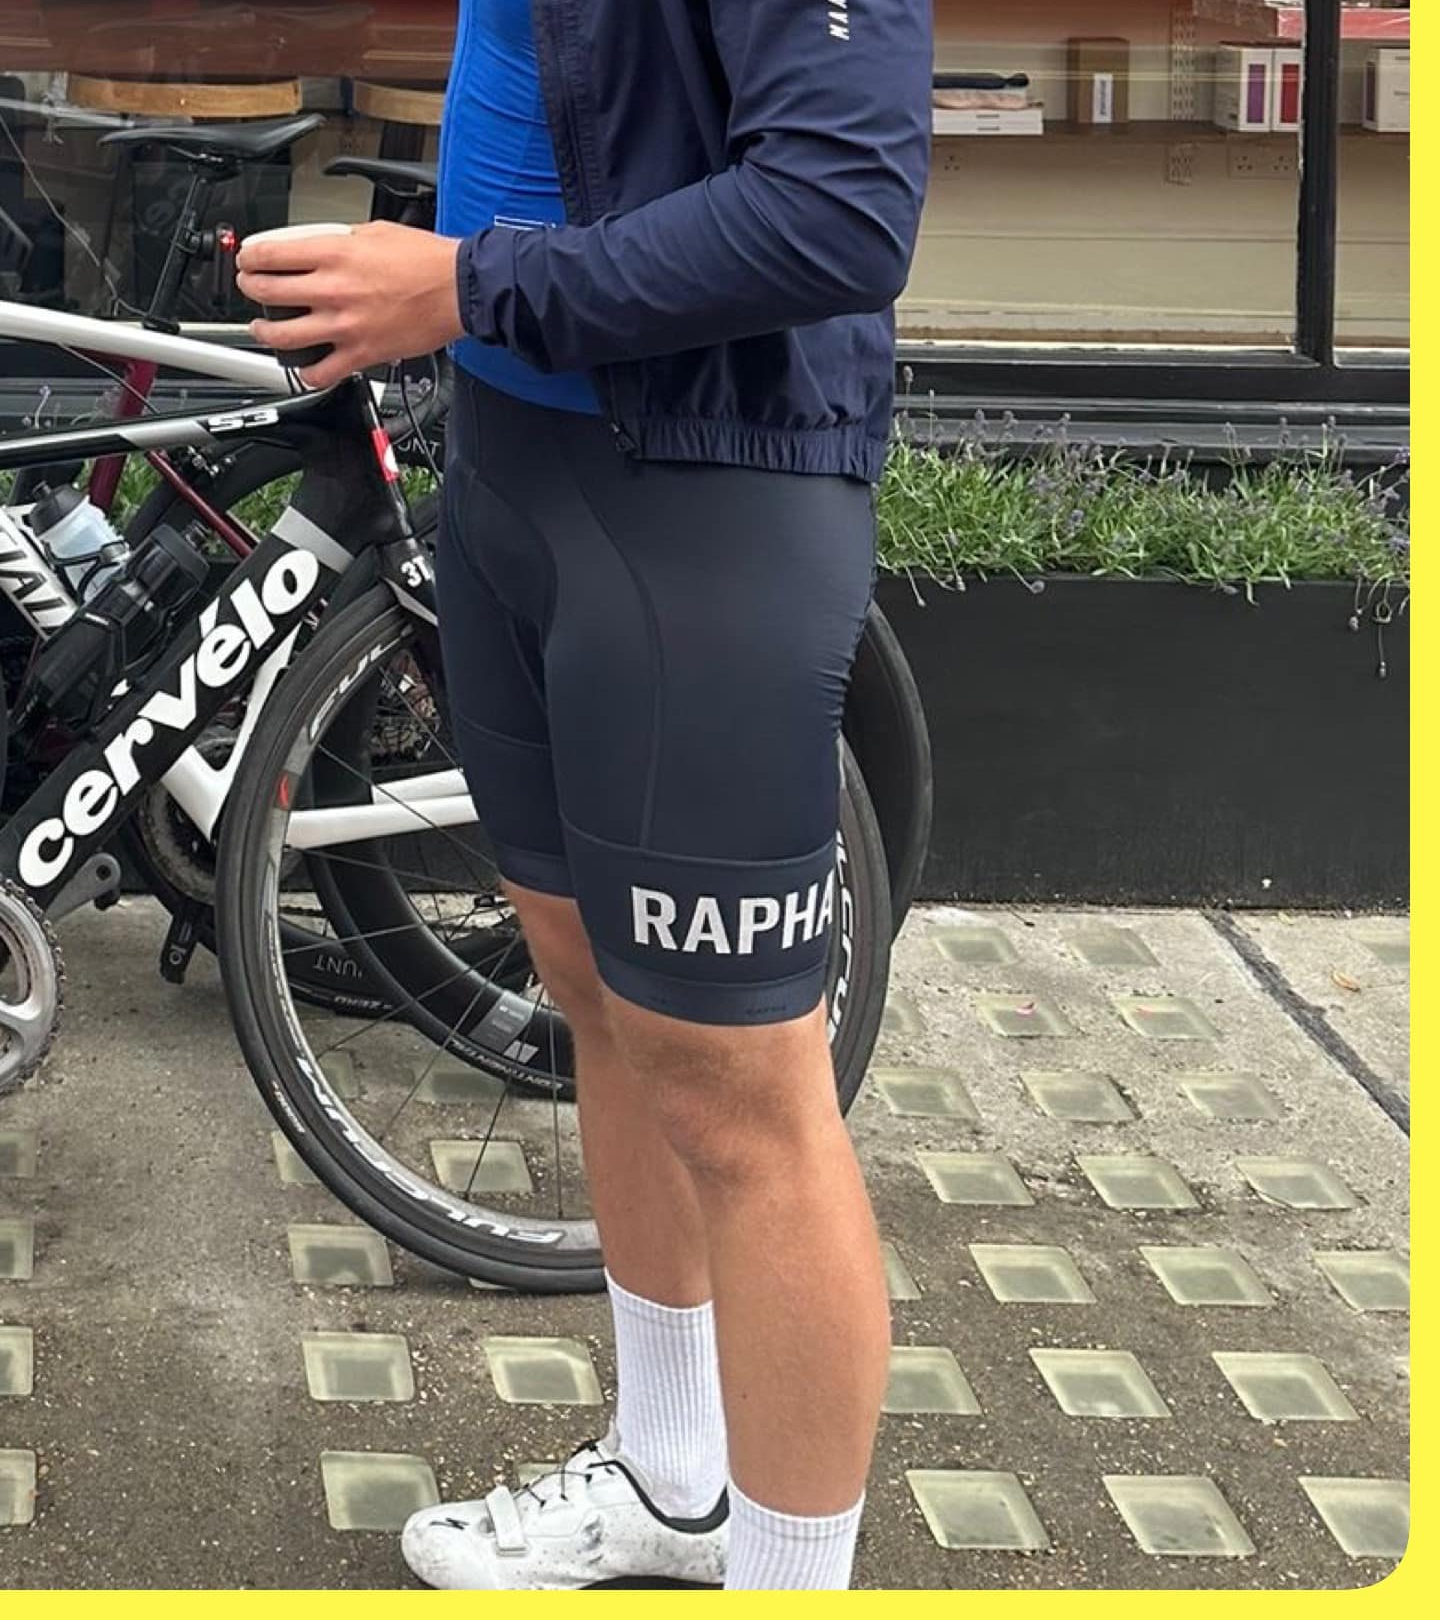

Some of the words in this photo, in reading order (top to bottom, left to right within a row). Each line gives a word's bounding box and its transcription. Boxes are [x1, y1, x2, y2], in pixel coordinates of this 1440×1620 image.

[207, 407, 280, 433] S3
[400, 554, 432, 588] 3T
[18, 548, 320, 888] cervélo
[630, 869, 837, 954] RAPHA
[313, 952, 363, 980] UNT
[296, 1056, 567, 1245] FULCRUM
